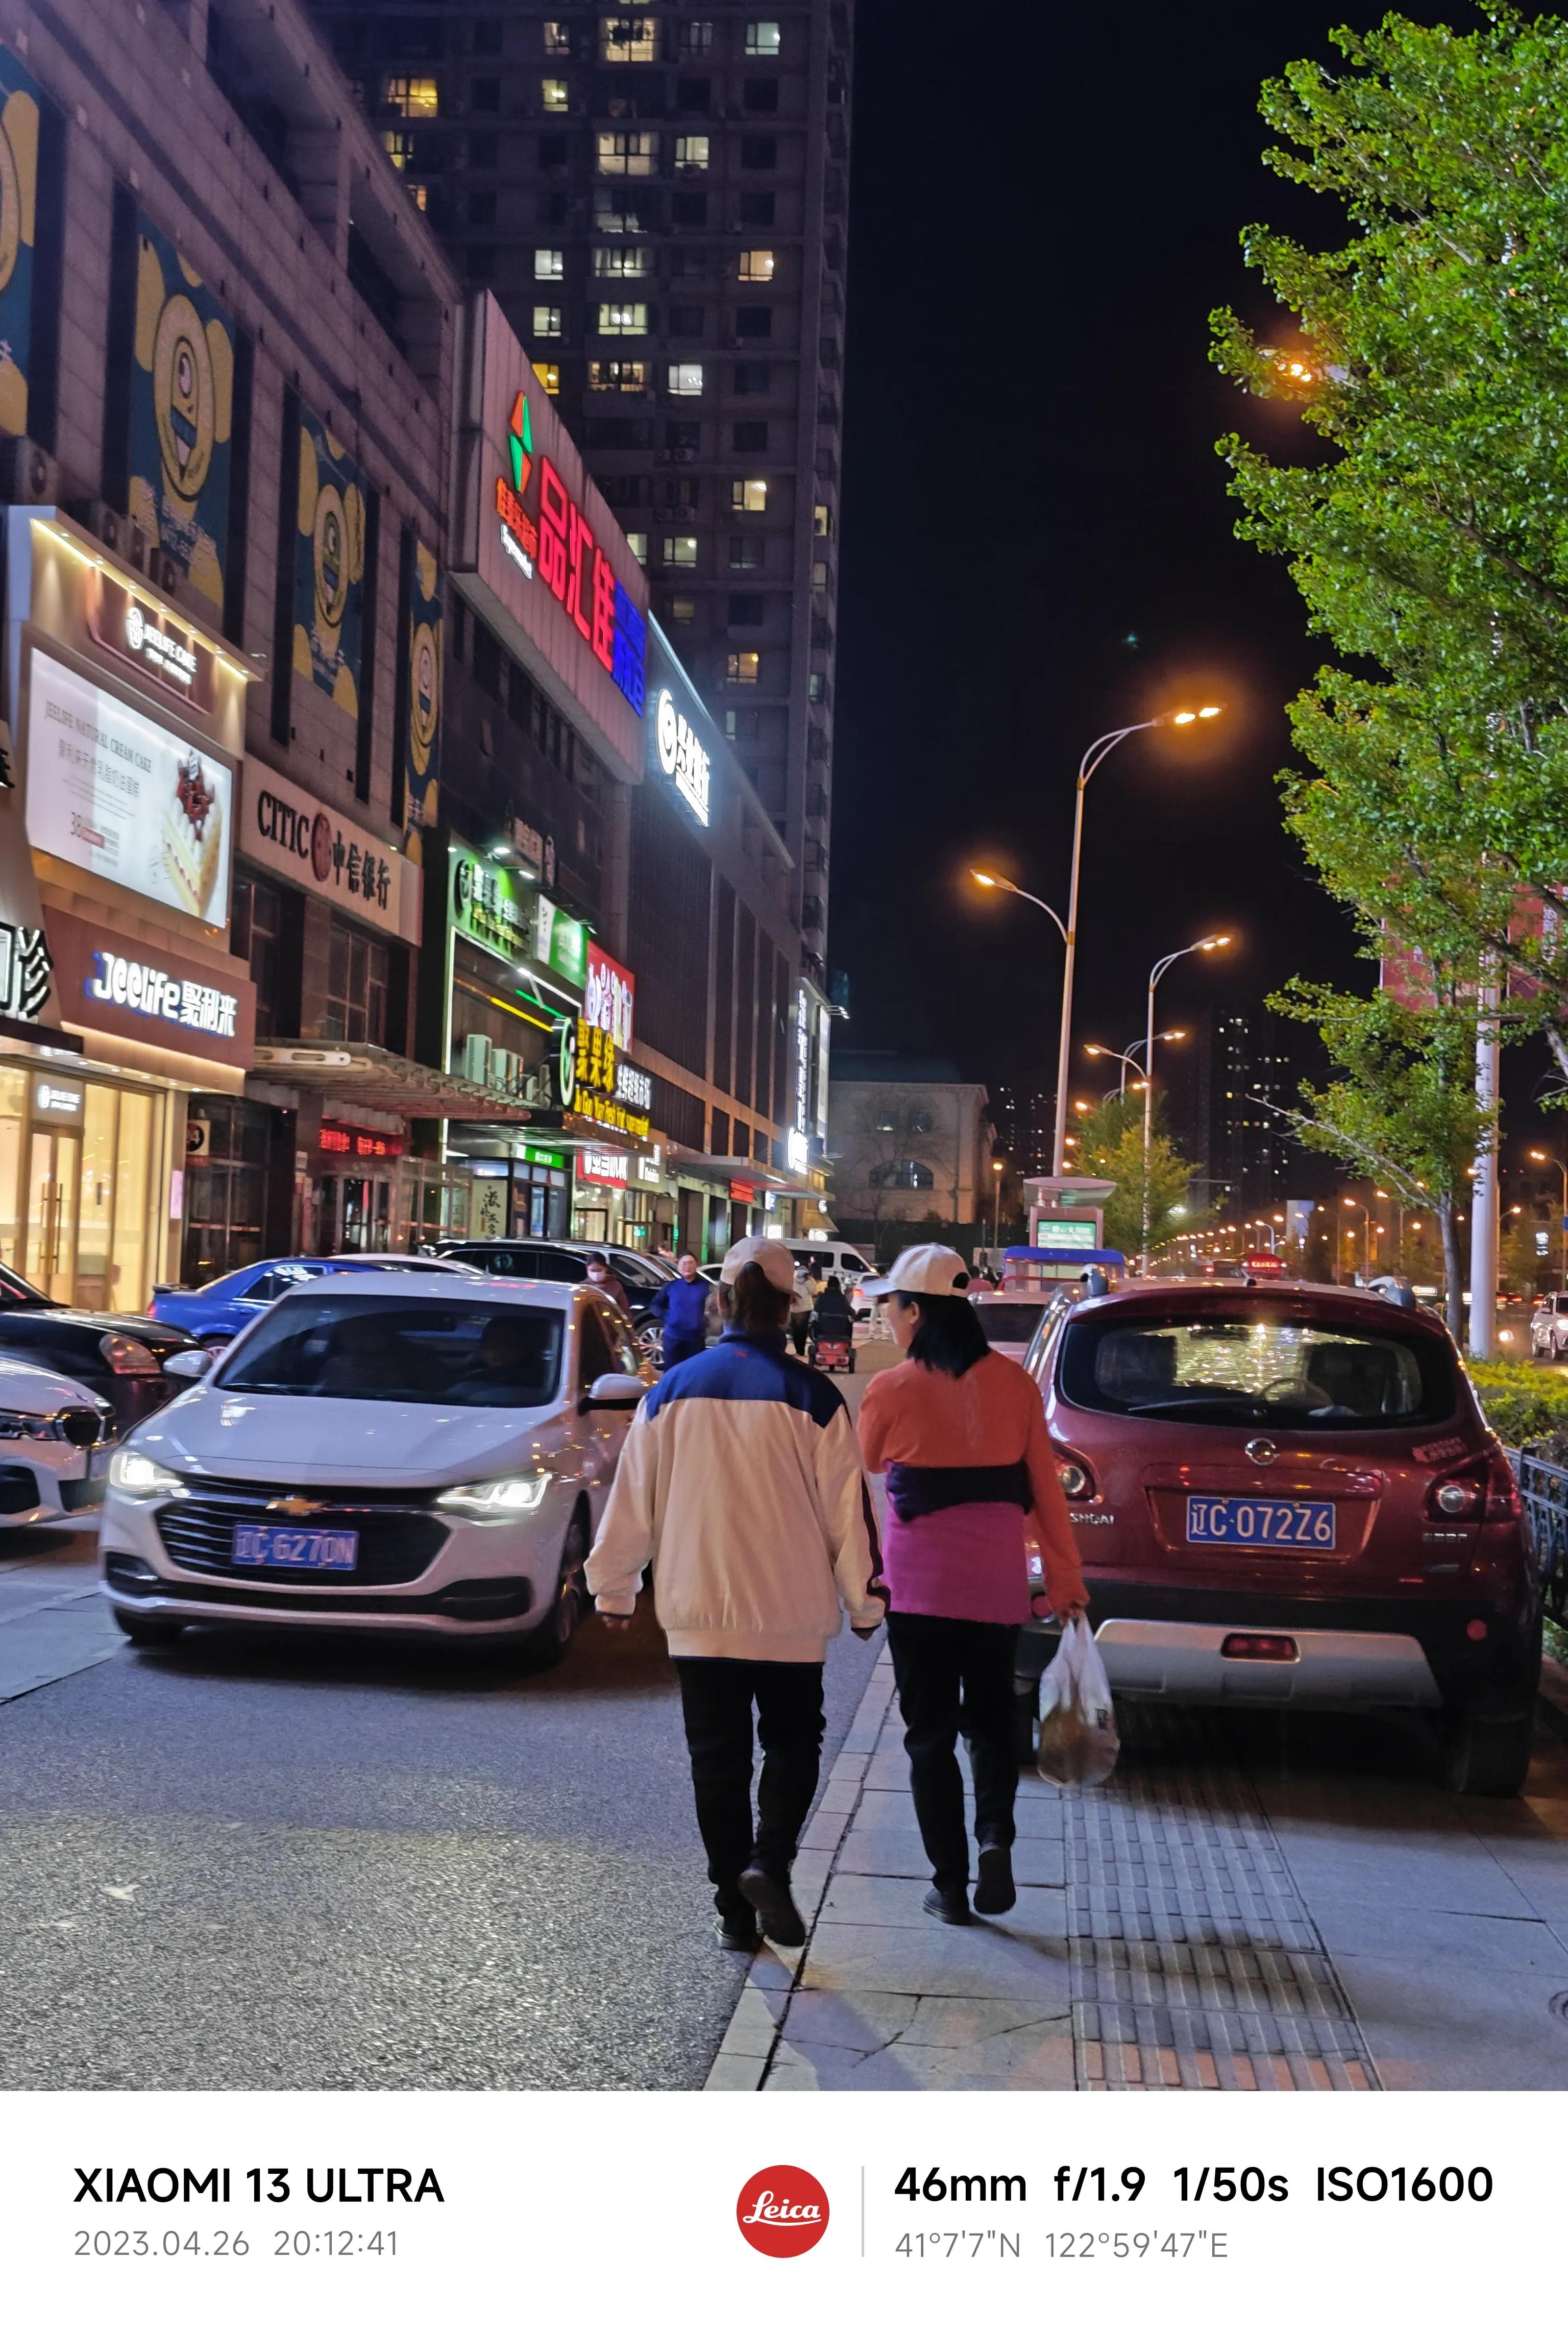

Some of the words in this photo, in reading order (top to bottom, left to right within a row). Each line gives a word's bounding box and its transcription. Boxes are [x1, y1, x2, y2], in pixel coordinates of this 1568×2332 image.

[539, 455, 615, 673] 品汇佳
[45, 700, 73, 728] JEELIFE
[75, 718, 108, 749] NATURAL
[111, 739, 133, 763] CREAM
[135, 753, 152, 773] CAKE
[258, 790, 309, 859] CITIC
[333, 830, 390, 910] 中信银行
[179, 980, 237, 1037] 聚利来
[1069, 1512, 1114, 1525] SHQAI
